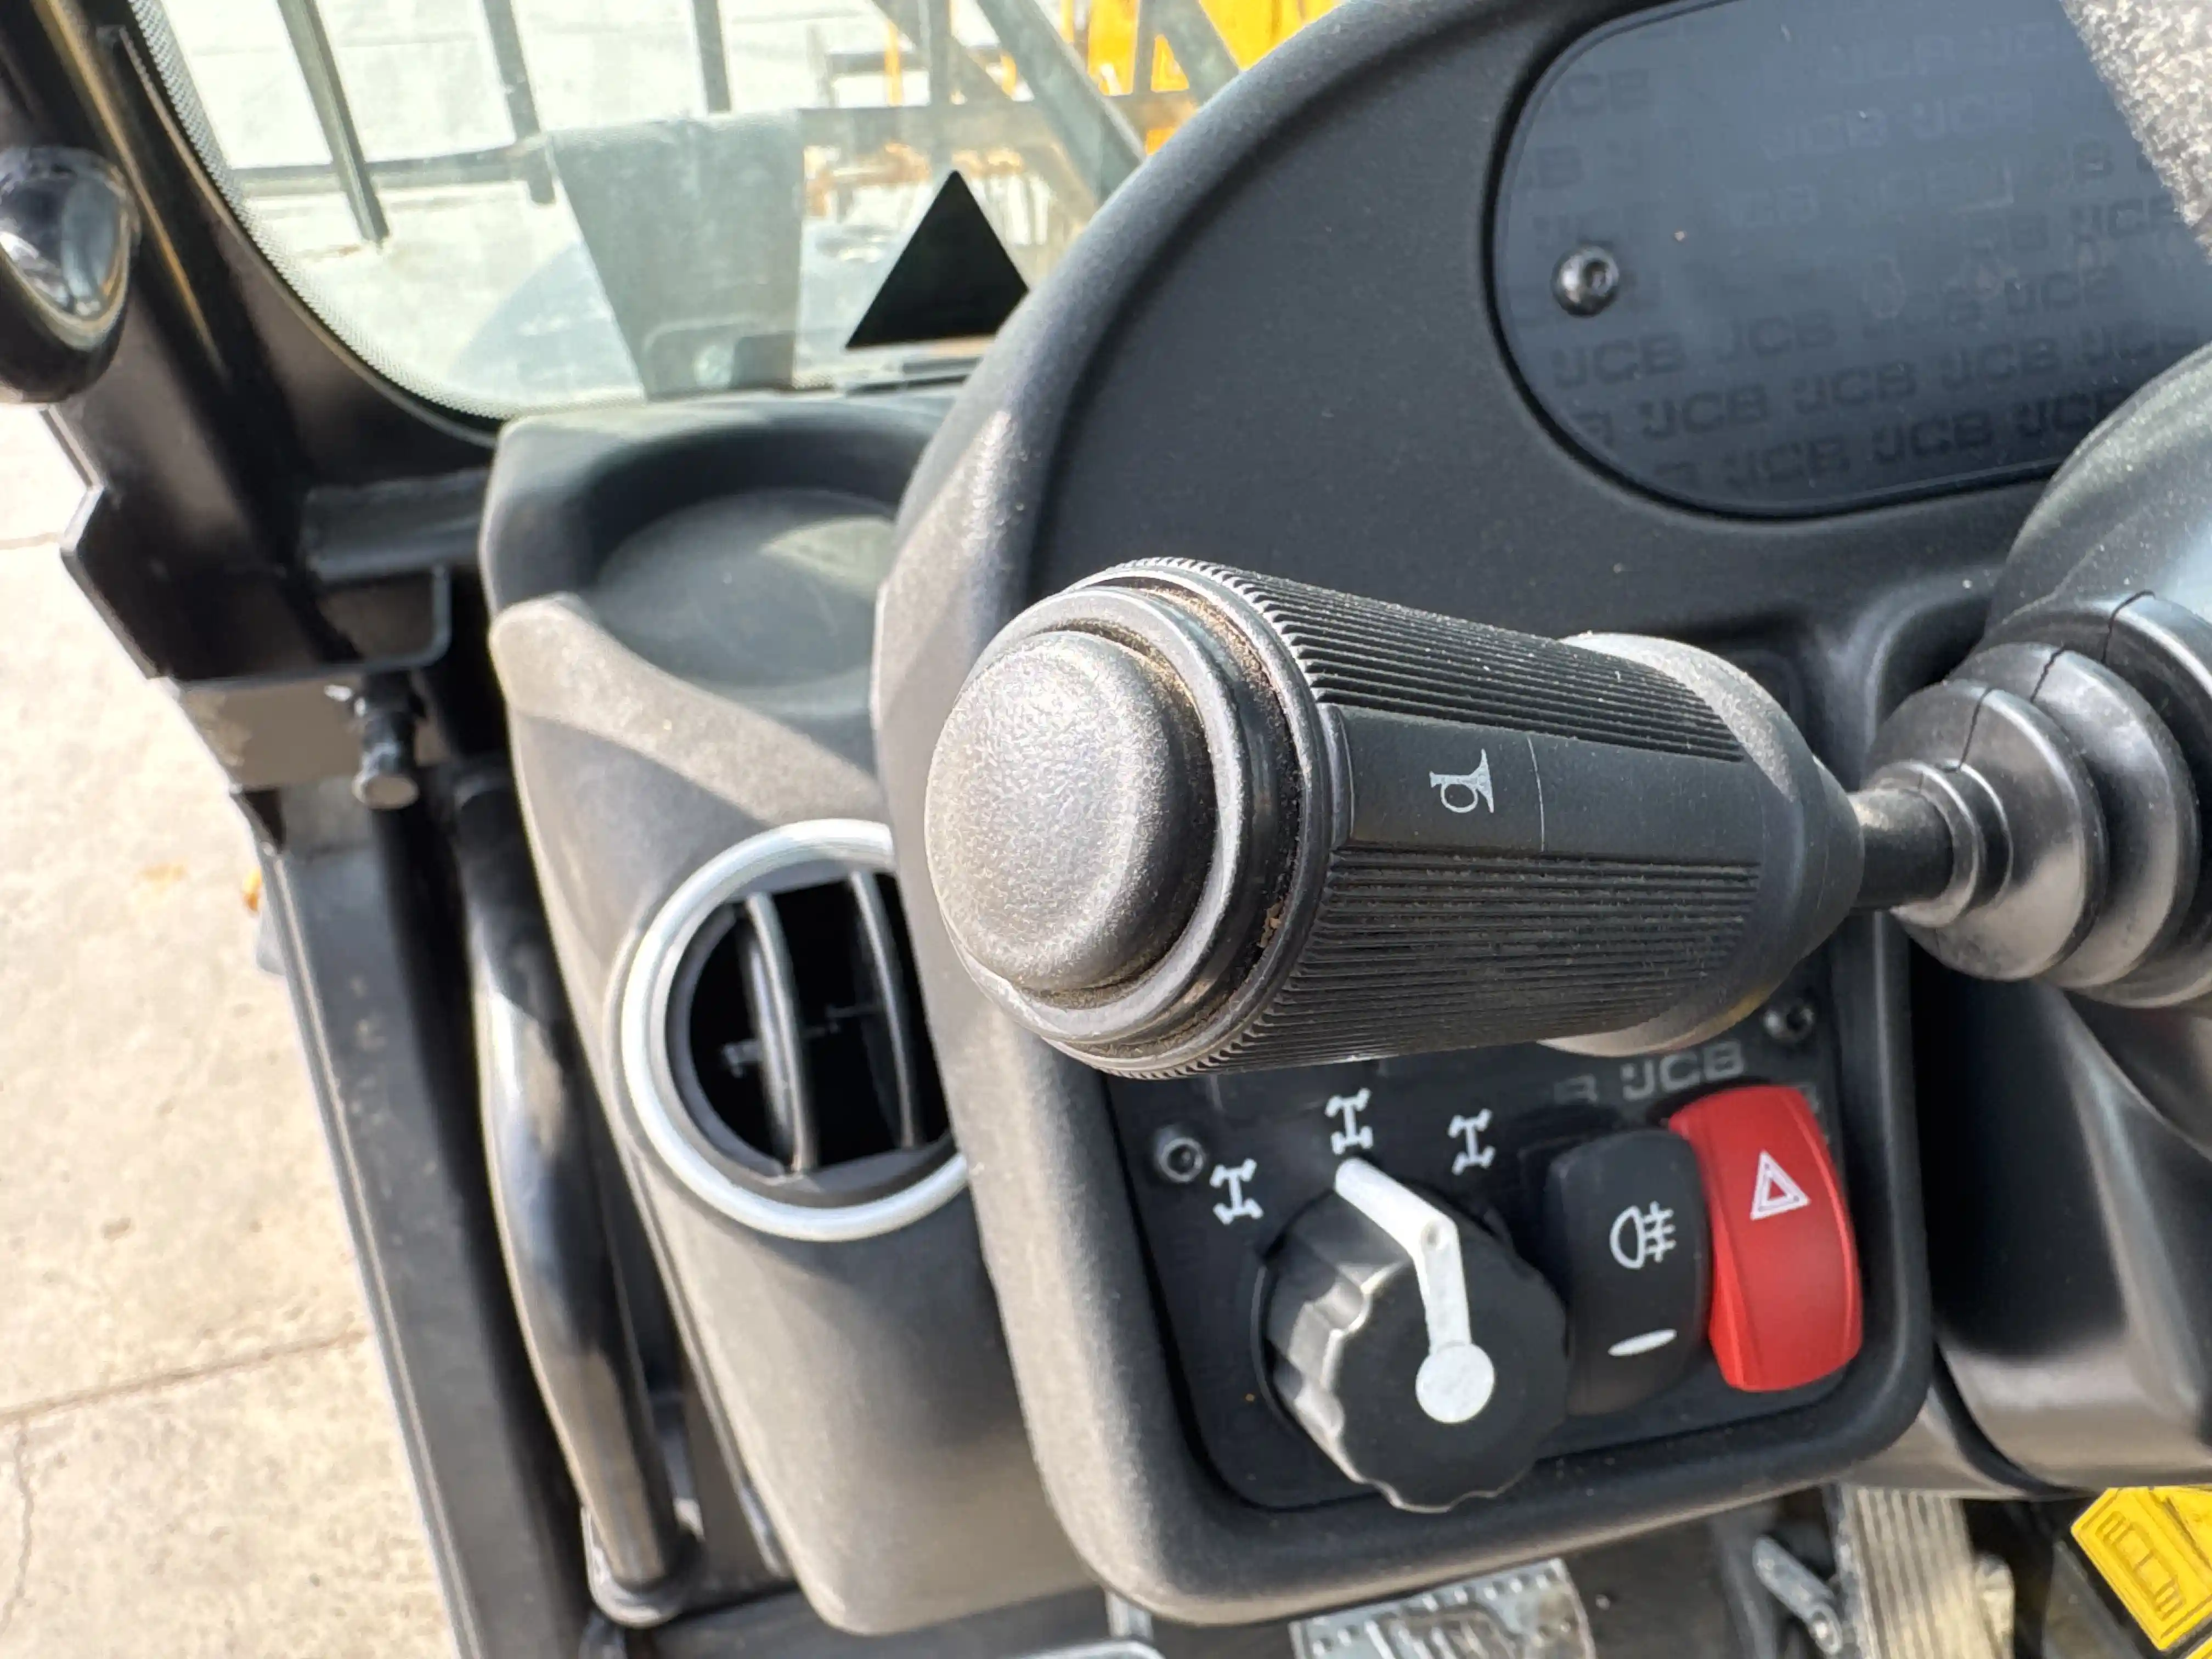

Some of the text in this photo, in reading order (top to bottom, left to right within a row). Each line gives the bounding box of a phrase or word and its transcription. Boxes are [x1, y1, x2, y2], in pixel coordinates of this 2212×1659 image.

[1551, 332, 1686, 389] JCB
[1637, 384, 1768, 440] JCB
[1793, 362, 1917, 416] JCB
[1942, 336, 2059, 391] JCB
[1871, 410, 1994, 465] JCB
[1620, 1039, 1747, 1102] JCB
